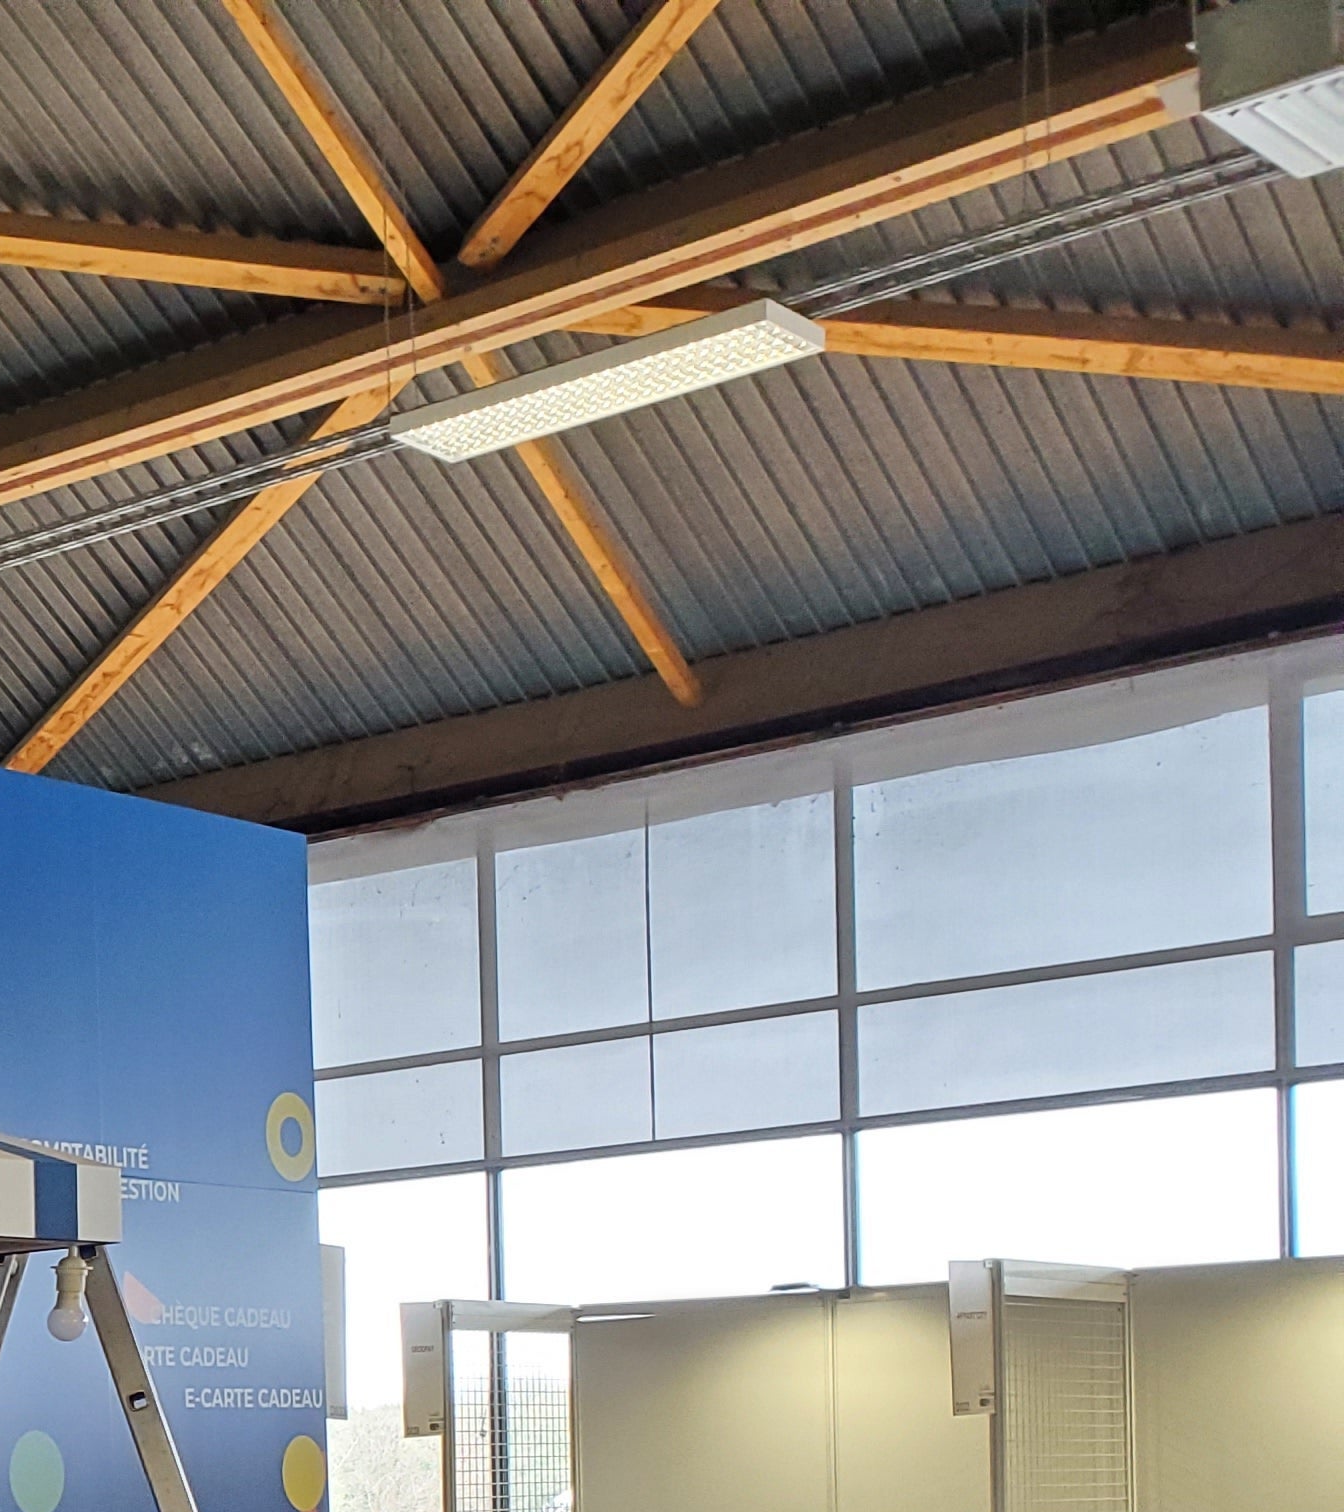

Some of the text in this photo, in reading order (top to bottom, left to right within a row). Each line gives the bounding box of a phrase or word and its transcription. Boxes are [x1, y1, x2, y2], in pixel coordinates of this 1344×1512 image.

[21, 1139, 149, 1170] PTABILITÉ
[120, 1178, 180, 1203] ESTION
[150, 1299, 292, 1330] CHÈQUE CADEAU
[143, 1345, 249, 1368] RTE CADEAU
[184, 1387, 324, 1409] E-CARTE CADEAU
